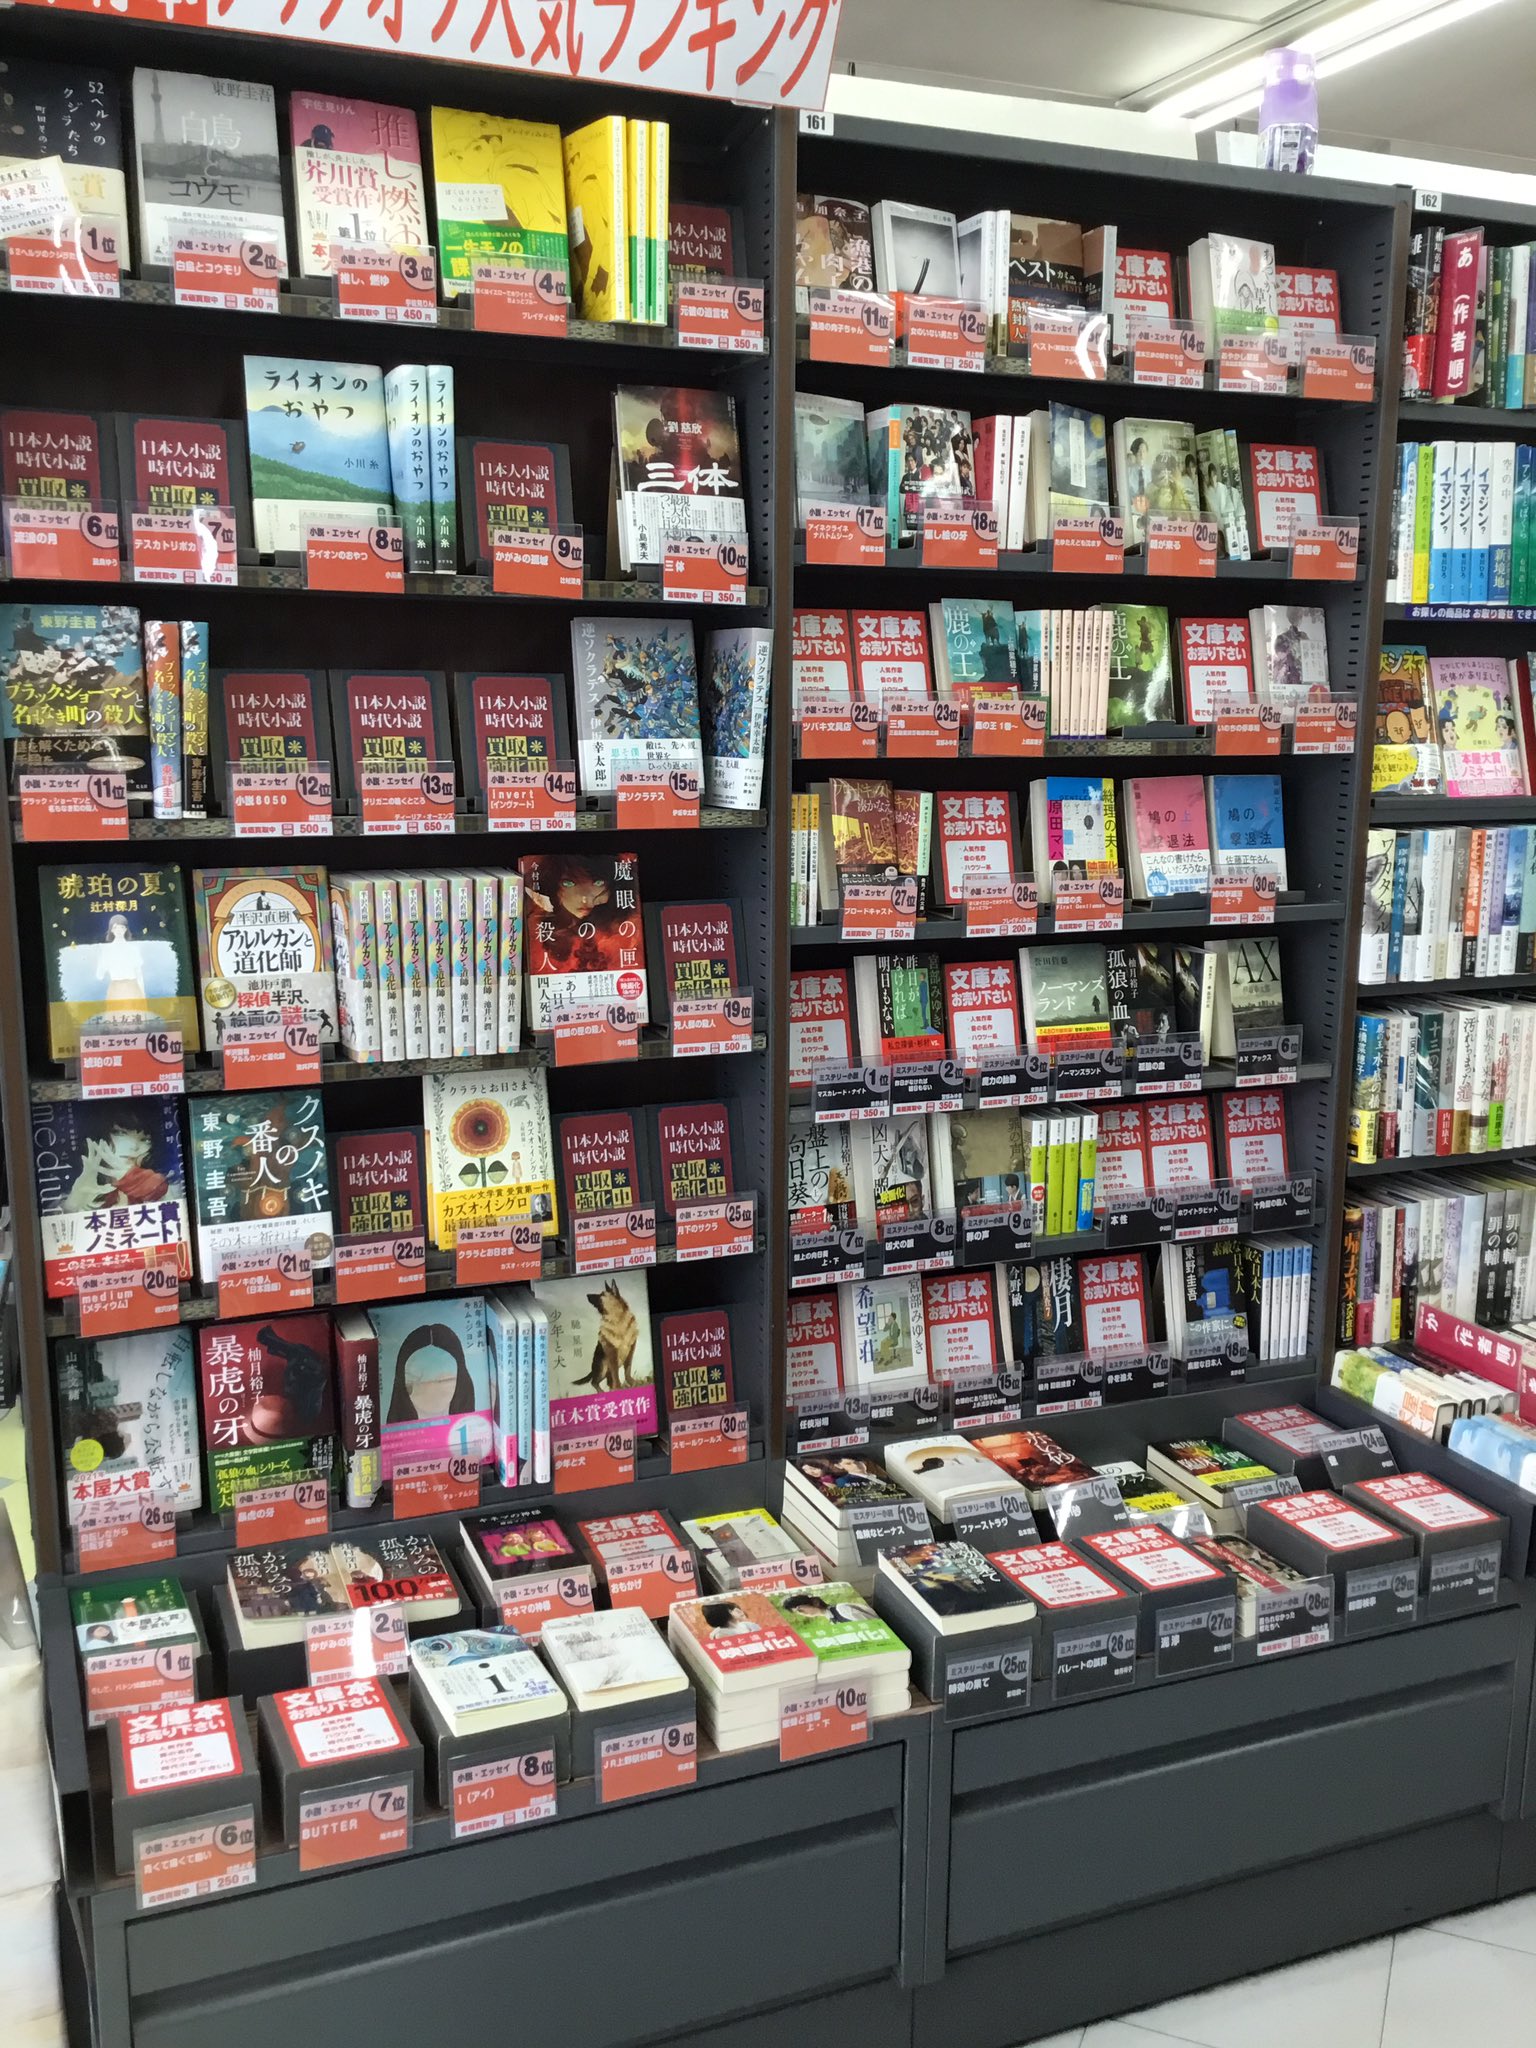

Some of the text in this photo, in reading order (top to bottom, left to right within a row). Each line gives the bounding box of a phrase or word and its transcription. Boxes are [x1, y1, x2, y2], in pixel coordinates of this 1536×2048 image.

[213, 81, 272, 103] 東野圭吾
[62, 87, 79, 156] クジラたち
[88, 82, 108, 146] 52ヘルツの
[806, 114, 826, 131] 161
[305, 160, 378, 192] 芥川賞
[1421, 194, 1437, 207] 162
[87, 228, 115, 253] 1位
[177, 239, 232, 254] 小説・エッセイ
[248, 244, 277, 269] 2位
[1458, 246, 1473, 268] あ
[175, 259, 242, 276] 白鳥とコウモリ
[404, 257, 432, 281] 3位
[1009, 257, 1055, 282] ペスト
[340, 272, 390, 287] 推し、燃ゆ
[539, 274, 567, 296] 4位
[682, 287, 727, 298] 小説・エッセイ
[737, 292, 761, 313] 5位
[863, 307, 889, 328] 11位
[961, 314, 985, 335] 12位
[1352, 347, 1374, 367] 16位
[264, 371, 367, 391] ライオンの
[283, 400, 355, 418] おやつ
[9, 432, 92, 452] 日本人小説
[409, 379, 424, 491] ライオンのおやつ
[16, 451, 87, 470] 時代小説
[1255, 449, 1313, 471] 文庫本
[480, 461, 549, 481] 日本人小説
[637, 462, 739, 494] 三体
[1256, 472, 1314, 488] お売り下さい
[486, 481, 545, 499] 時代小説
[88, 515, 118, 539] 6位
[808, 524, 848, 532] アイネクライネ
[858, 509, 883, 529] 17位
[375, 529, 402, 552] 8位
[440, 516, 450, 548] 小川糸
[1196, 524, 1217, 543] 20位
[558, 542, 582, 561] 9位
[638, 524, 649, 561] 小島秀夫
[308, 550, 368, 561] ライオンのおやつ
[664, 559, 684, 572] 三体
[720, 547, 746, 567] 10位
[40, 615, 96, 629] 東野圭吾
[1412, 607, 1470, 619] お探しの商品は
[1473, 609, 1514, 619] お取り寄せ
[858, 616, 922, 638] 文庫本
[1186, 624, 1245, 644] 文庫本
[946, 606, 976, 677] 鹿の王
[757, 644, 769, 705] 逆ソクラテス
[6, 683, 144, 709] ブラック・ショーマンと
[231, 694, 306, 709] 日本人小説
[13, 705, 143, 725] 名もなき町の殺人
[238, 712, 302, 727] 時代小説
[853, 704, 877, 723] 22位
[25, 779, 80, 789] 小説・エッセイ
[94, 779, 125, 799] 11位
[424, 776, 453, 795] 13位
[547, 774, 575, 793] 14位
[618, 791, 665, 802] 逆ソクラテス
[943, 798, 1004, 818] 文庫本
[57, 870, 164, 899] 琥珀の夏
[1101, 884, 1122, 903] 29位
[894, 889, 915, 907] 27位
[238, 912, 289, 925] 半沢直樹
[223, 928, 313, 952] アルルカンと
[234, 951, 302, 973] 道化師
[1232, 941, 1278, 984] AX
[248, 979, 292, 990] 池井戸潤
[894, 955, 906, 1020] なければ
[906, 955, 919, 1002] 昨日が
[1038, 976, 1104, 996] ノーマンズ
[1107, 950, 1130, 1020] 孤狼の血
[878, 955, 894, 1035] 明日もない
[1038, 996, 1076, 1012] ランド
[1281, 1038, 1298, 1053] 6位
[944, 1062, 963, 1079] 2位
[449, 1082, 528, 1095] クララとお日さま
[1149, 1103, 1205, 1126] 文庫本
[566, 1130, 629, 1149] 日本人小説
[200, 1112, 227, 1217] 東野圭吾
[808, 1124, 829, 1188] 盤上の
[789, 1136, 806, 1206] 向日葵
[84, 1201, 180, 1231] 本屋大賞
[442, 1199, 527, 1218] カズオ・イシグロ
[87, 1223, 183, 1252] ノミネート!
[515, 1227, 540, 1247] 23位
[677, 1223, 718, 1236] 月下のサクラ
[845, 1232, 864, 1248] 7位
[146, 1273, 178, 1290] 20位
[1185, 1246, 1198, 1301] 東野圭吾
[927, 1280, 986, 1303] 文庫本
[858, 1285, 875, 1363] 希望荘
[909, 1278, 924, 1354] 宮部みゆき
[549, 1311, 567, 1369] 少年と犬
[248, 1348, 264, 1406] 柚月裕子
[206, 1336, 248, 1445] 暴虎の牙
[353, 1395, 374, 1448] 暴虎の牙
[551, 1399, 650, 1427] 直木賞受賞作
[73, 1471, 150, 1501] 本屋大賞
[298, 1484, 325, 1502] 27位
[1268, 1494, 1333, 1513] 文庫本
[855, 1526, 904, 1539] 危険なビーナス
[960, 1518, 1008, 1533] ファーストラヴ
[610, 1580, 643, 1594] おもかげ
[374, 1613, 404, 1633] 2位
[1209, 1614, 1233, 1631] 27位
[717, 1636, 796, 1660] 映画化!
[949, 1678, 990, 1694] 時効の果て
[838, 1688, 867, 1707] 10位
[127, 1704, 224, 1733] 文庫本
[457, 1764, 511, 1783] 小説・エッセイ
[524, 1756, 553, 1777] 8位
[380, 1792, 405, 1811] 7位
[220, 1825, 253, 1846] 6位
[302, 1818, 358, 1839] BUTTER
